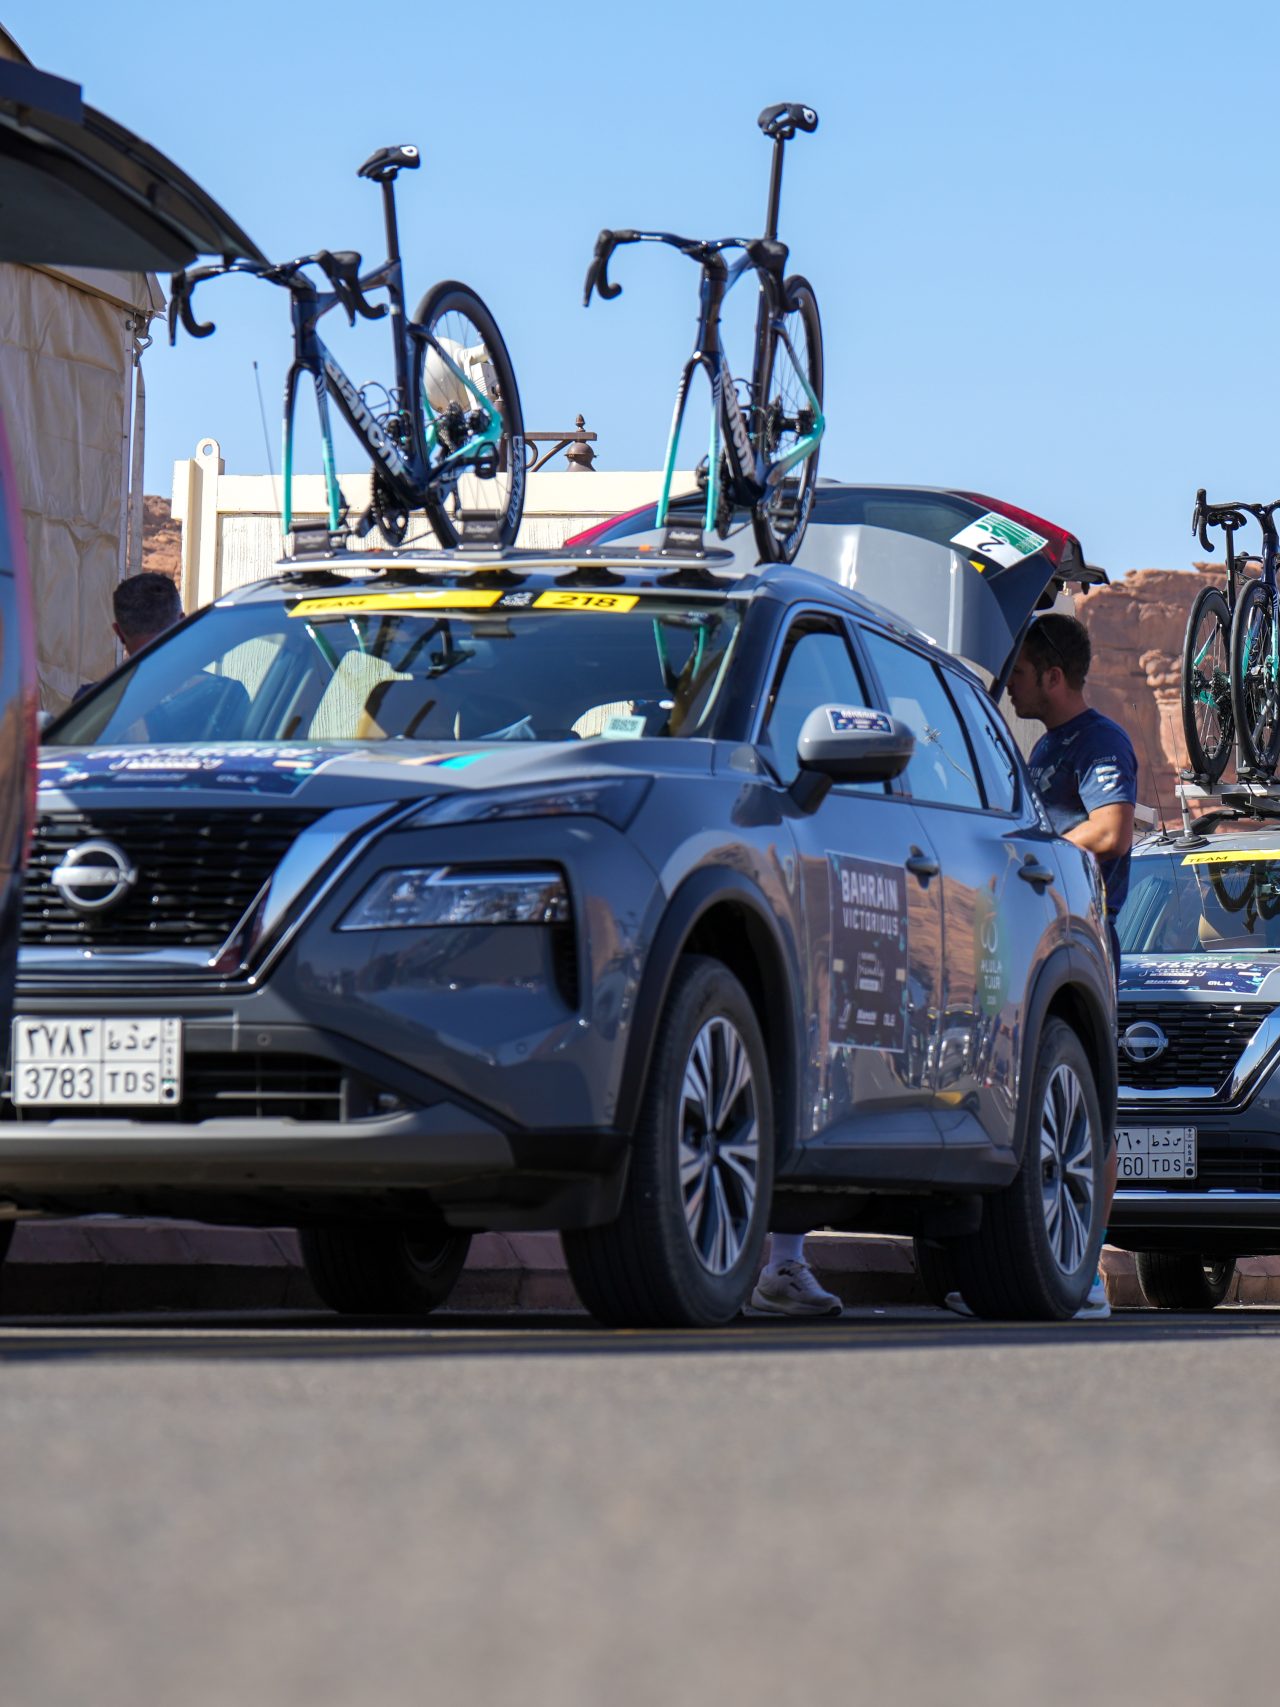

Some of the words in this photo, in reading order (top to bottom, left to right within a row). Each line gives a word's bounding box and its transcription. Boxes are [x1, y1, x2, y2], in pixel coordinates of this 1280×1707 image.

[305, 600, 366, 610] TEAM
[552, 595, 618, 608] 218
[1188, 855, 1228, 863] TEAM
[841, 869, 898, 911] BAHRAIN
[843, 907, 898, 936] VICTORIOUS
[25, 1068, 94, 1099] 3783
[107, 1072, 156, 1093] TDS
[1152, 1159, 1181, 1173] TDS
